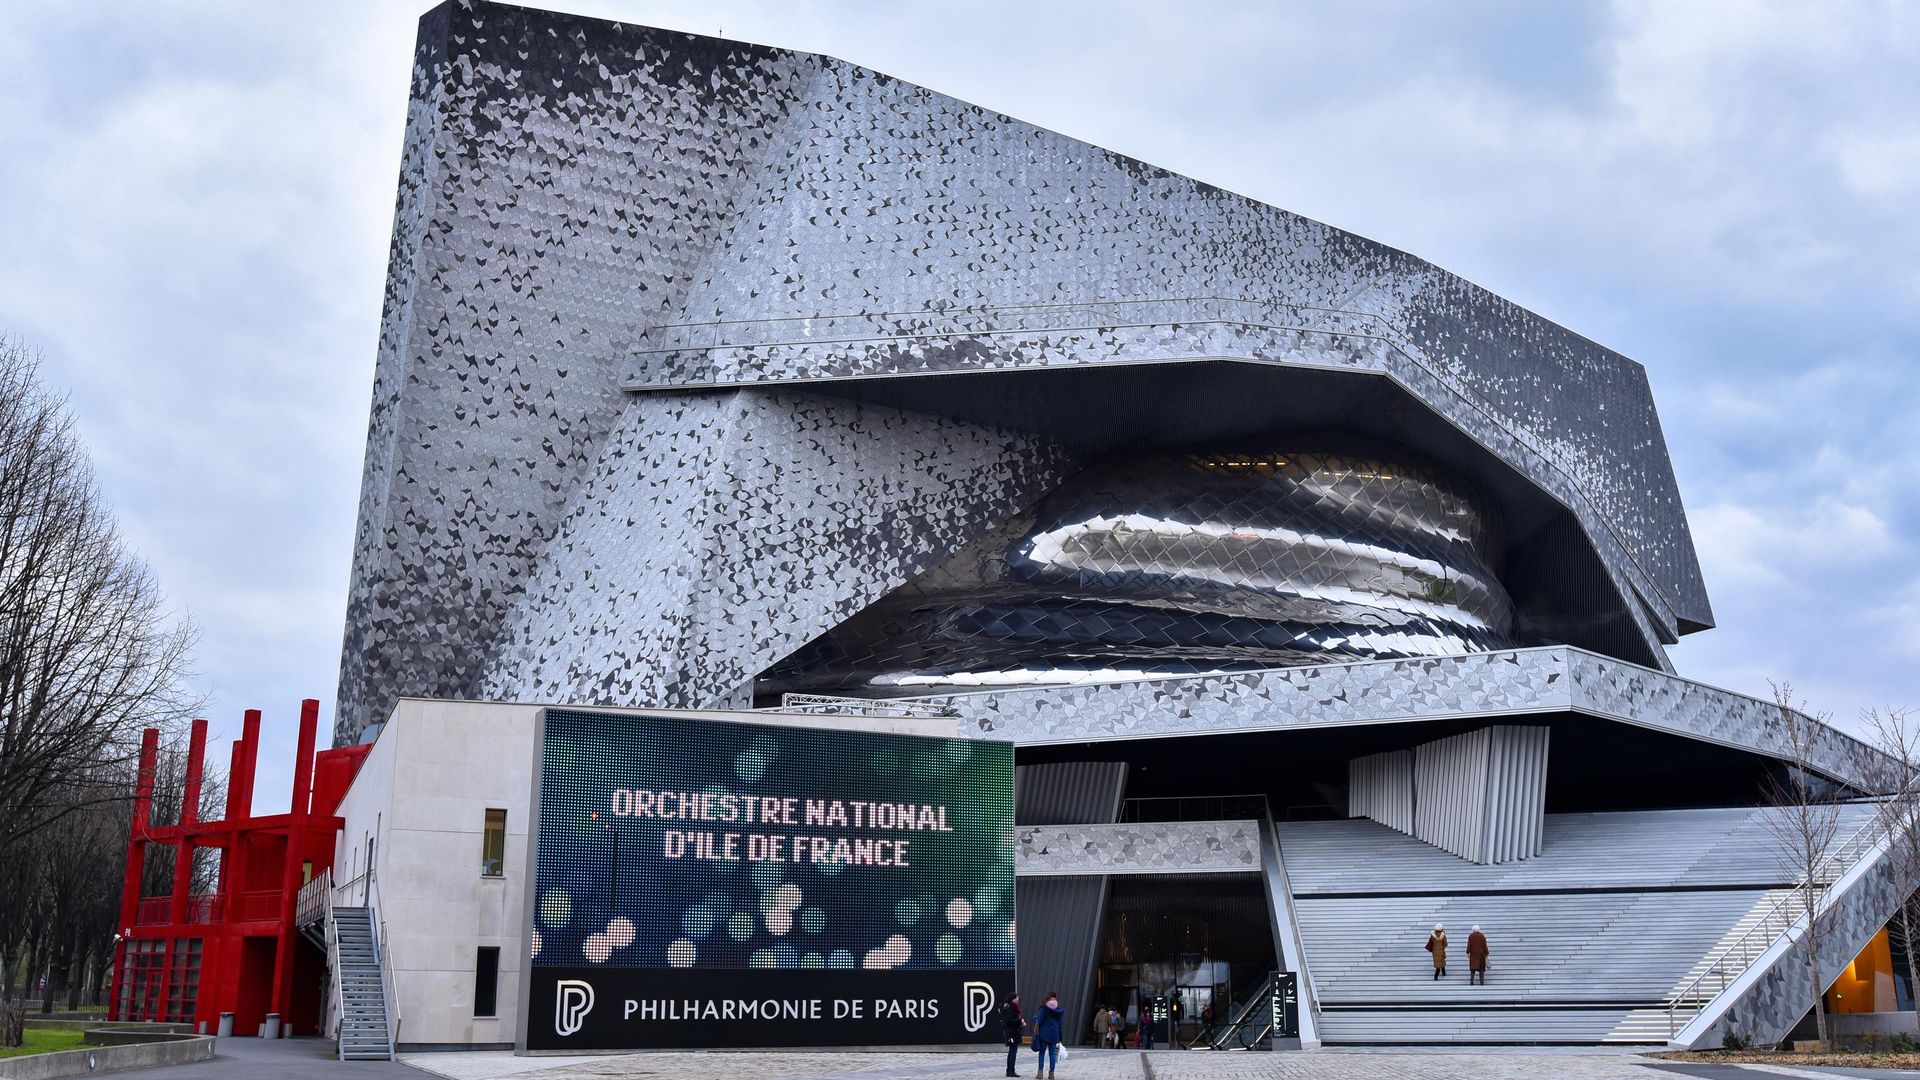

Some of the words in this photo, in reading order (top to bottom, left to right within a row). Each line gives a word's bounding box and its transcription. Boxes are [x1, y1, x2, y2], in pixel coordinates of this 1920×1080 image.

[612, 789, 798, 824] ORCHESTRE
[806, 799, 954, 831] NATIONAL
[664, 830, 740, 860] D'ILE
[749, 834, 786, 862] DE
[793, 836, 910, 867] FRANCE
[624, 999, 822, 1020] PHILHARMONIE
[833, 999, 864, 1019] DE
[875, 999, 939, 1019] PARIS
